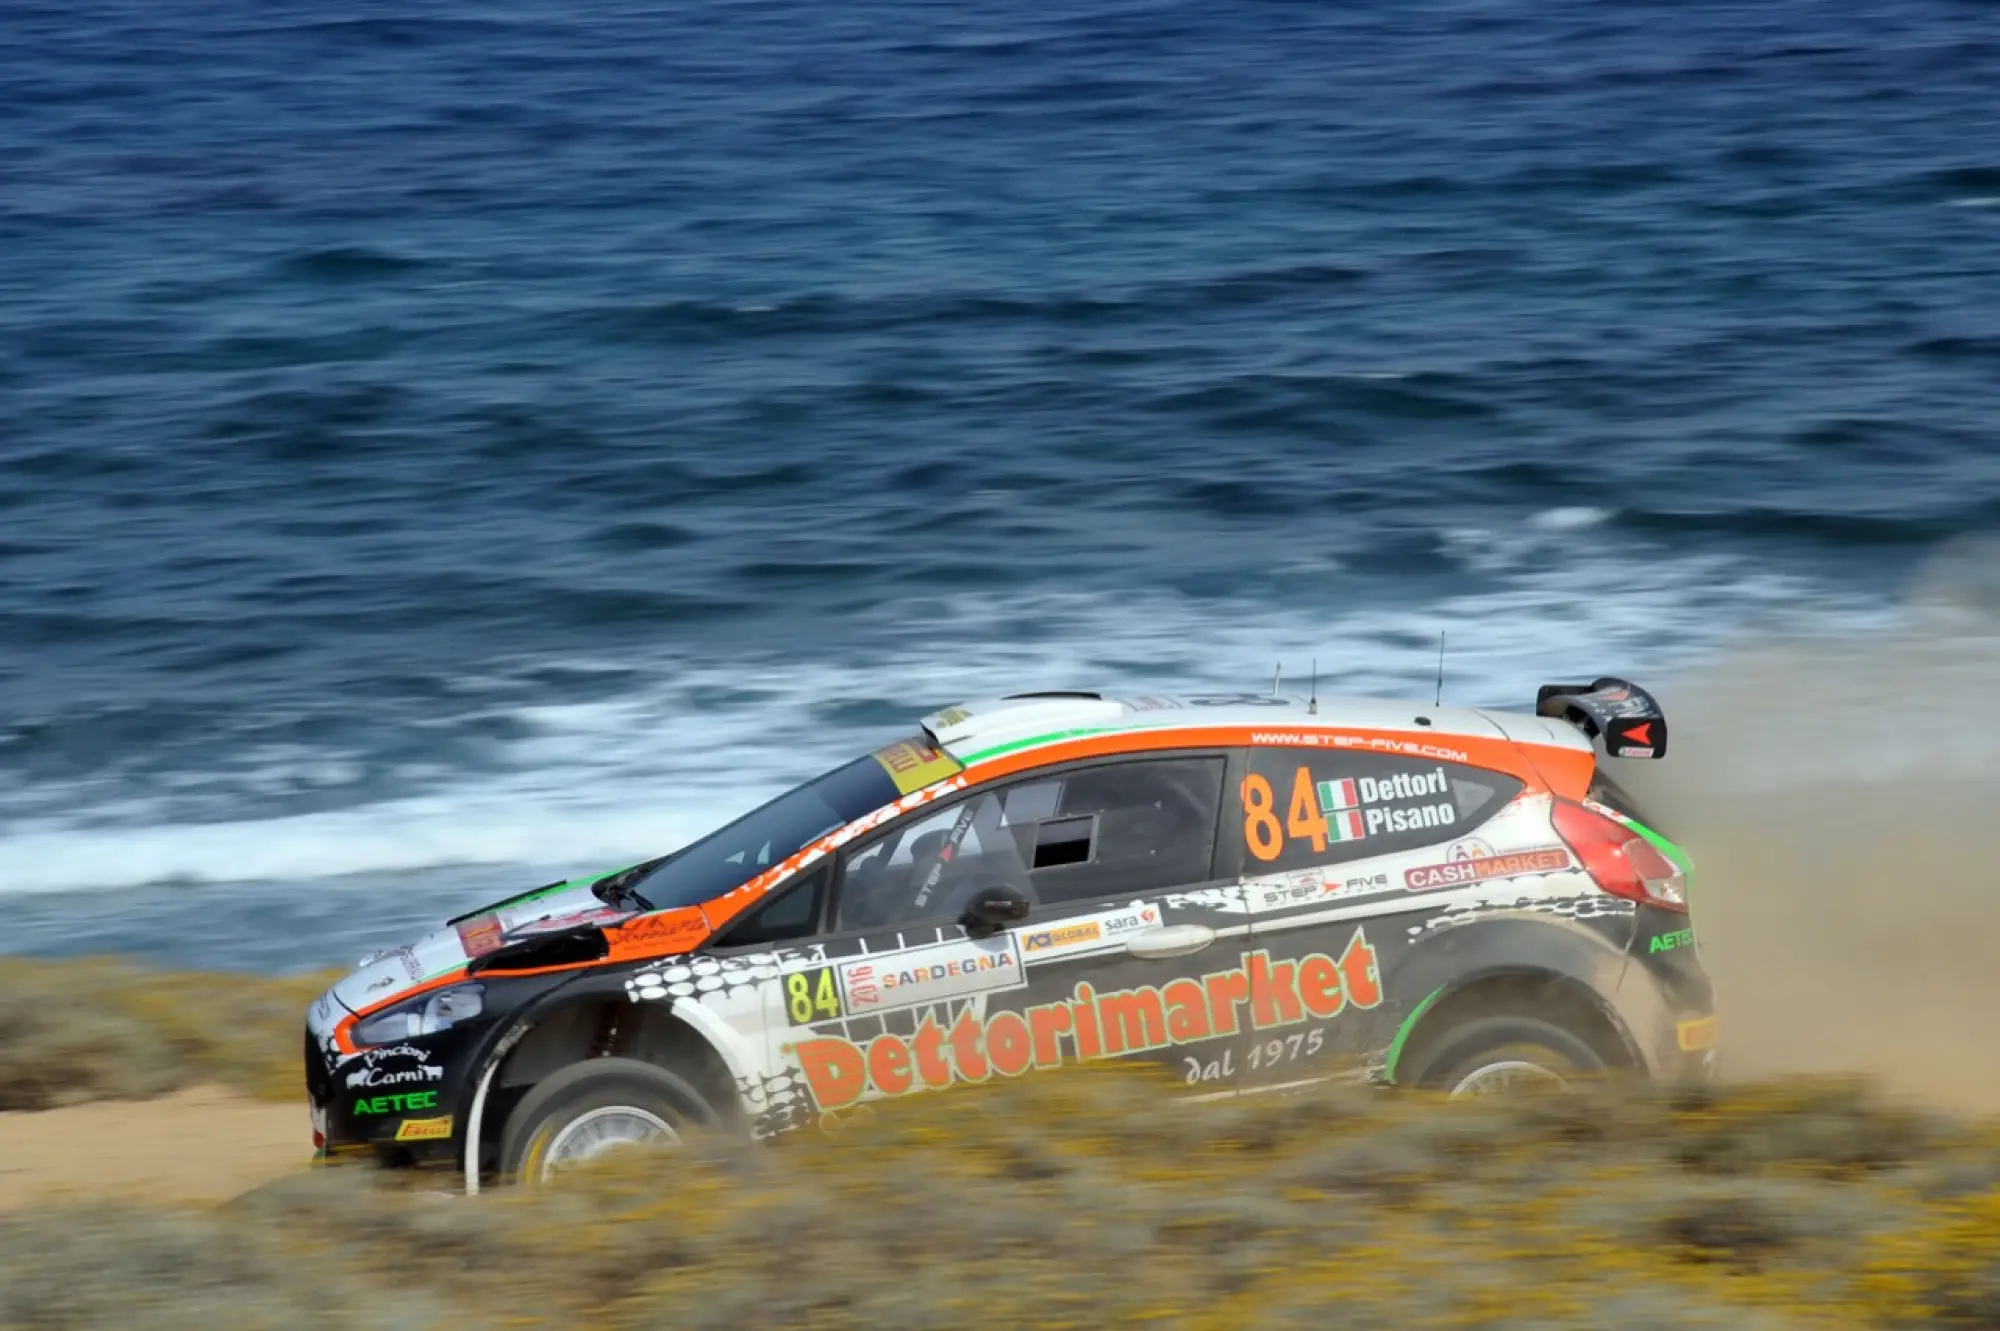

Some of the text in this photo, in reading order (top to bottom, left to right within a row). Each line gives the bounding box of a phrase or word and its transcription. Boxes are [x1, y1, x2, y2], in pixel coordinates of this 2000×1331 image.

[1251, 732, 1468, 762] WWW.STEP-FIVE.COM
[1358, 767, 1448, 804] Dettori
[1240, 766, 1327, 862] 84
[1366, 803, 1456, 835] Pisano
[1346, 873, 1388, 890] FIVE
[1105, 915, 1139, 932] sara
[847, 963, 879, 1009] 2016
[881, 951, 1014, 989] SARDEGNA
[788, 967, 840, 1023] 84
[790, 925, 1383, 1113] Dettorimarket
[364, 1063, 424, 1087] Carni
[1183, 1028, 1325, 1085] dal 1975
[353, 1090, 438, 1116] AETEC
